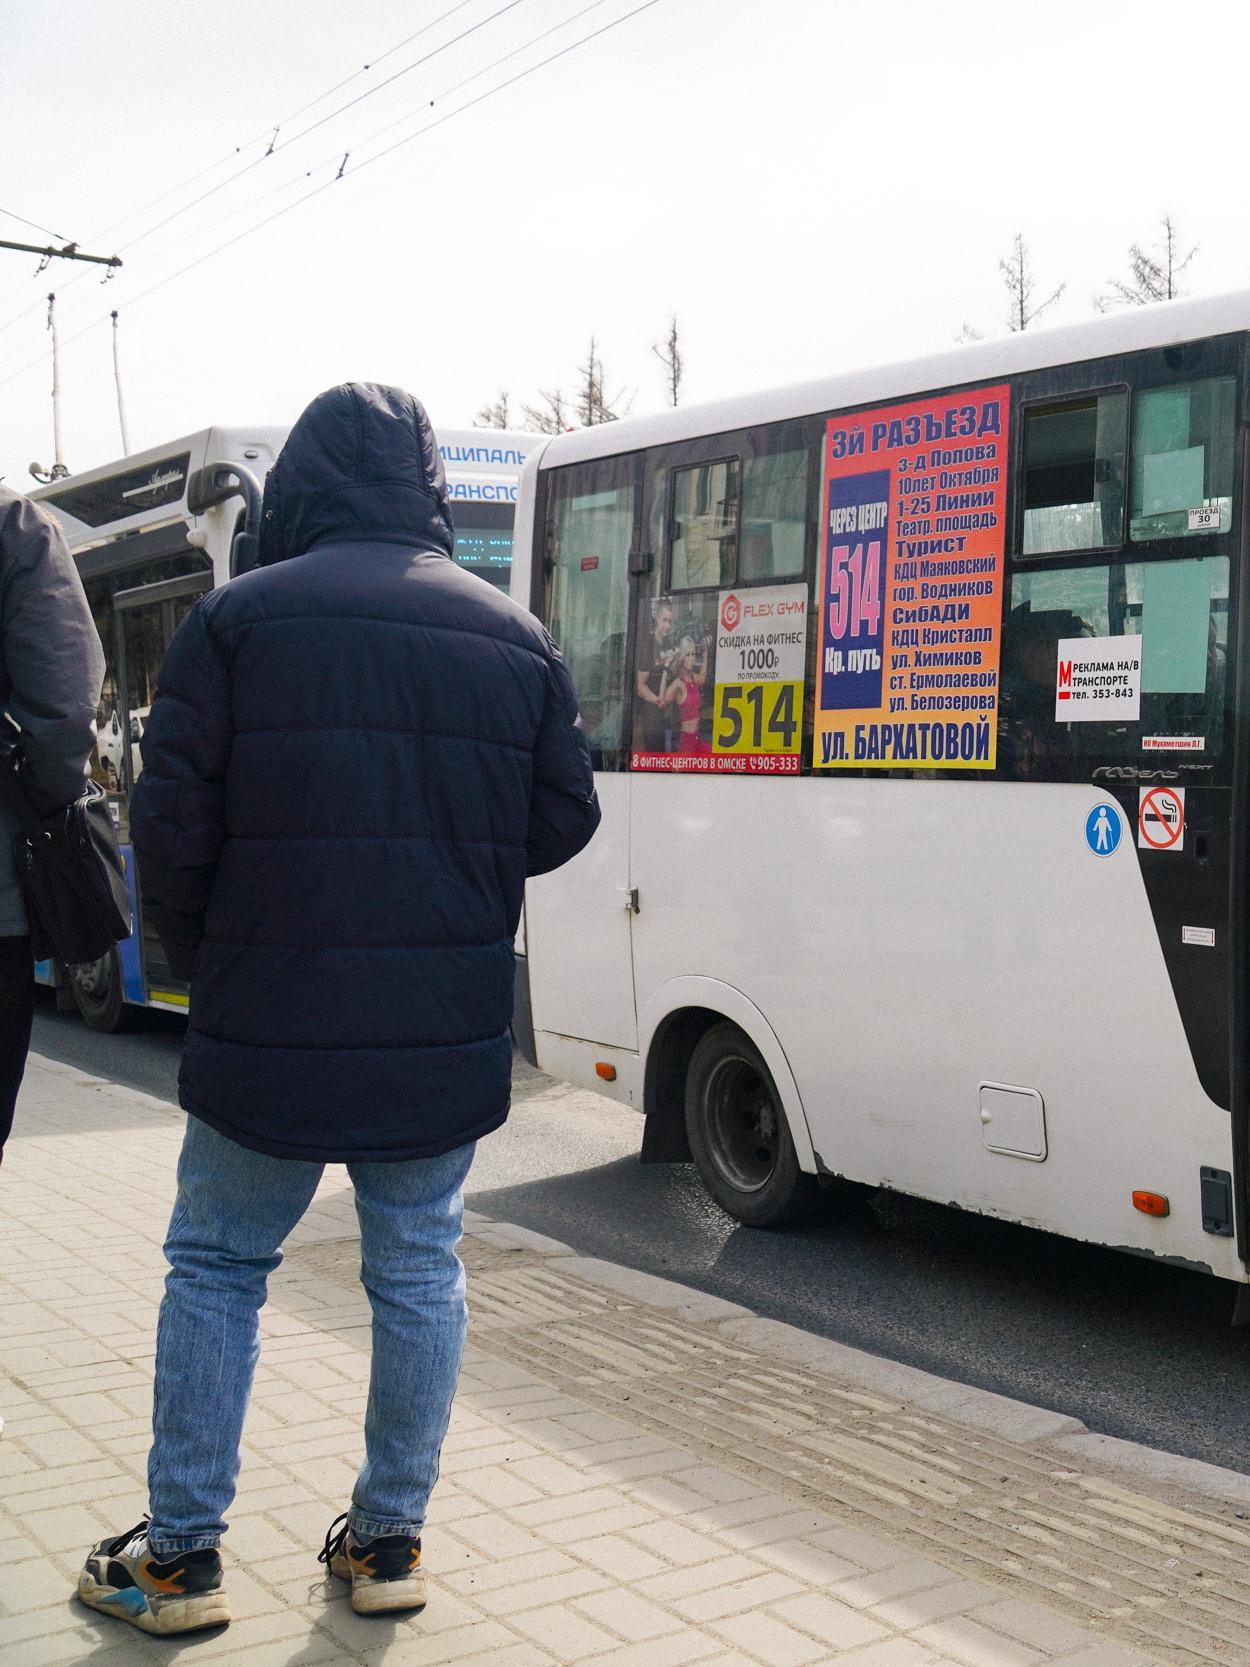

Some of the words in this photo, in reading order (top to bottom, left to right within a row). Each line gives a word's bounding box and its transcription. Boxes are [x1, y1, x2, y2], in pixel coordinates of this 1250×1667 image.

[871, 400, 1001, 452] РАЗЪЕЗД
[930, 442, 996, 466] Попова
[940, 466, 999, 490] Октября
[898, 496, 931, 517] 1-25
[934, 490, 995, 513] Линии
[1189, 508, 1219, 516] ПРОЕЗД
[830, 506, 857, 534] ЧЕРЕЗ
[858, 501, 887, 534] ЦЕНТР
[896, 519, 933, 538] Театр.
[935, 511, 998, 534] площадь
[1198, 515, 1211, 523] 30
[896, 536, 967, 558] Турист
[894, 561, 917, 581] КДЦ
[920, 554, 996, 579] Маяковский
[829, 541, 881, 640] 514
[893, 586, 917, 602] гор.
[921, 580, 993, 599] Водников
[743, 604, 774, 618] FLEX
[777, 601, 805, 616] GYM
[892, 603, 970, 624] СибАДИ
[719, 636, 751, 649] СКИДКА
[753, 634, 765, 646] НА
[767, 632, 804, 645] ФИТНЕС
[891, 630, 919, 648] КДЦ
[922, 627, 992, 645] Кристалл
[825, 647, 846, 675] Кр.
[847, 648, 880, 674] путь
[891, 655, 912, 670] ул.
[914, 650, 982, 668] Химиков
[1073, 662, 1115, 673] РЕКЛАМА
[1117, 660, 1139, 671] НА/В
[890, 675, 908, 690] ст.
[910, 669, 997, 690] Ермолаевой
[1072, 675, 1129, 687] ТРАНСПОРТЕ
[889, 696, 909, 713] ул.
[910, 694, 995, 712] Белозерова
[1072, 691, 1090, 700] тел.
[1092, 688, 1134, 699] 353-843
[718, 685, 797, 748] 514
[821, 732, 849, 764] ул.
[854, 715, 989, 761] БАРХАТОВОЙ
[633, 754, 639, 768] 8
[640, 757, 709, 771] ФИТНЕС-ЦЕНТРОВ
[710, 758, 716, 769] В
[718, 758, 747, 770] ОМСКЕ
[758, 756, 798, 771] 905-333
